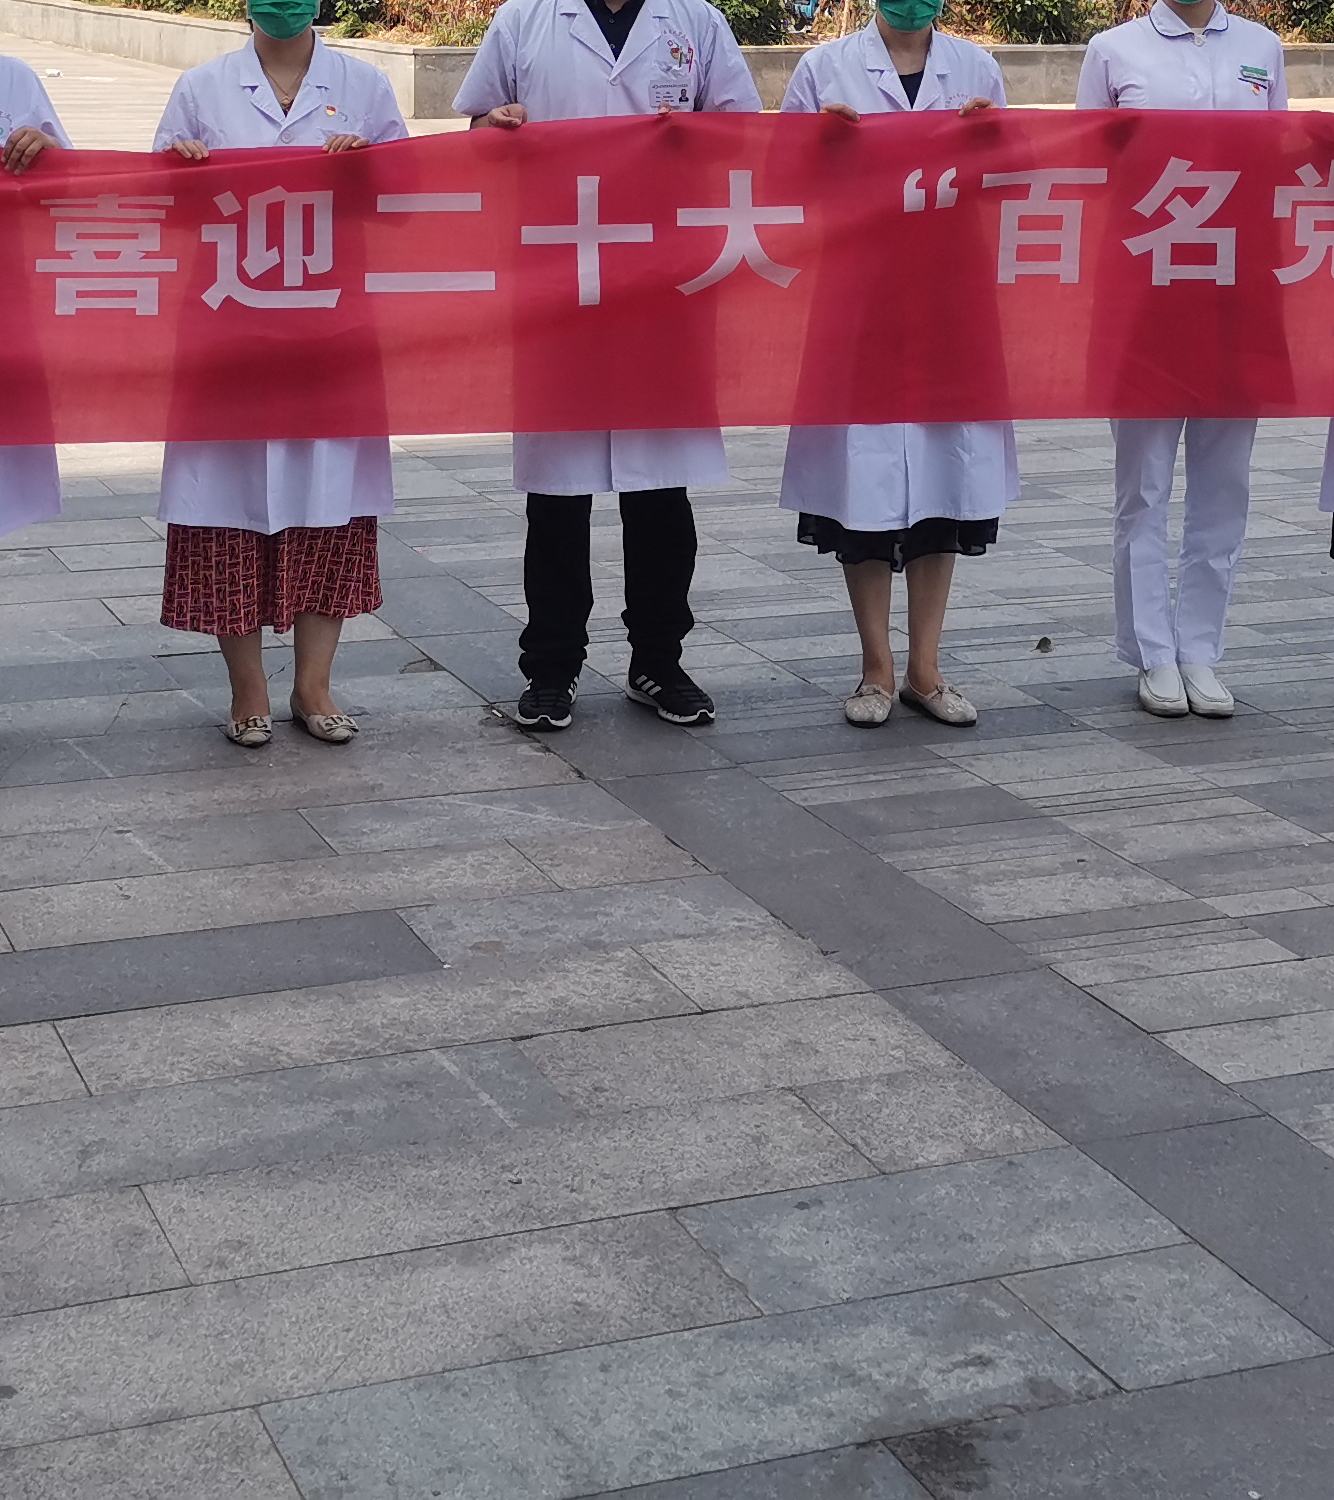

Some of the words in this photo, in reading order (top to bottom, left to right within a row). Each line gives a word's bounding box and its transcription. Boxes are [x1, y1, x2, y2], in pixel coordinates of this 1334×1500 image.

[34, 169, 805, 316] 喜迎二十大
